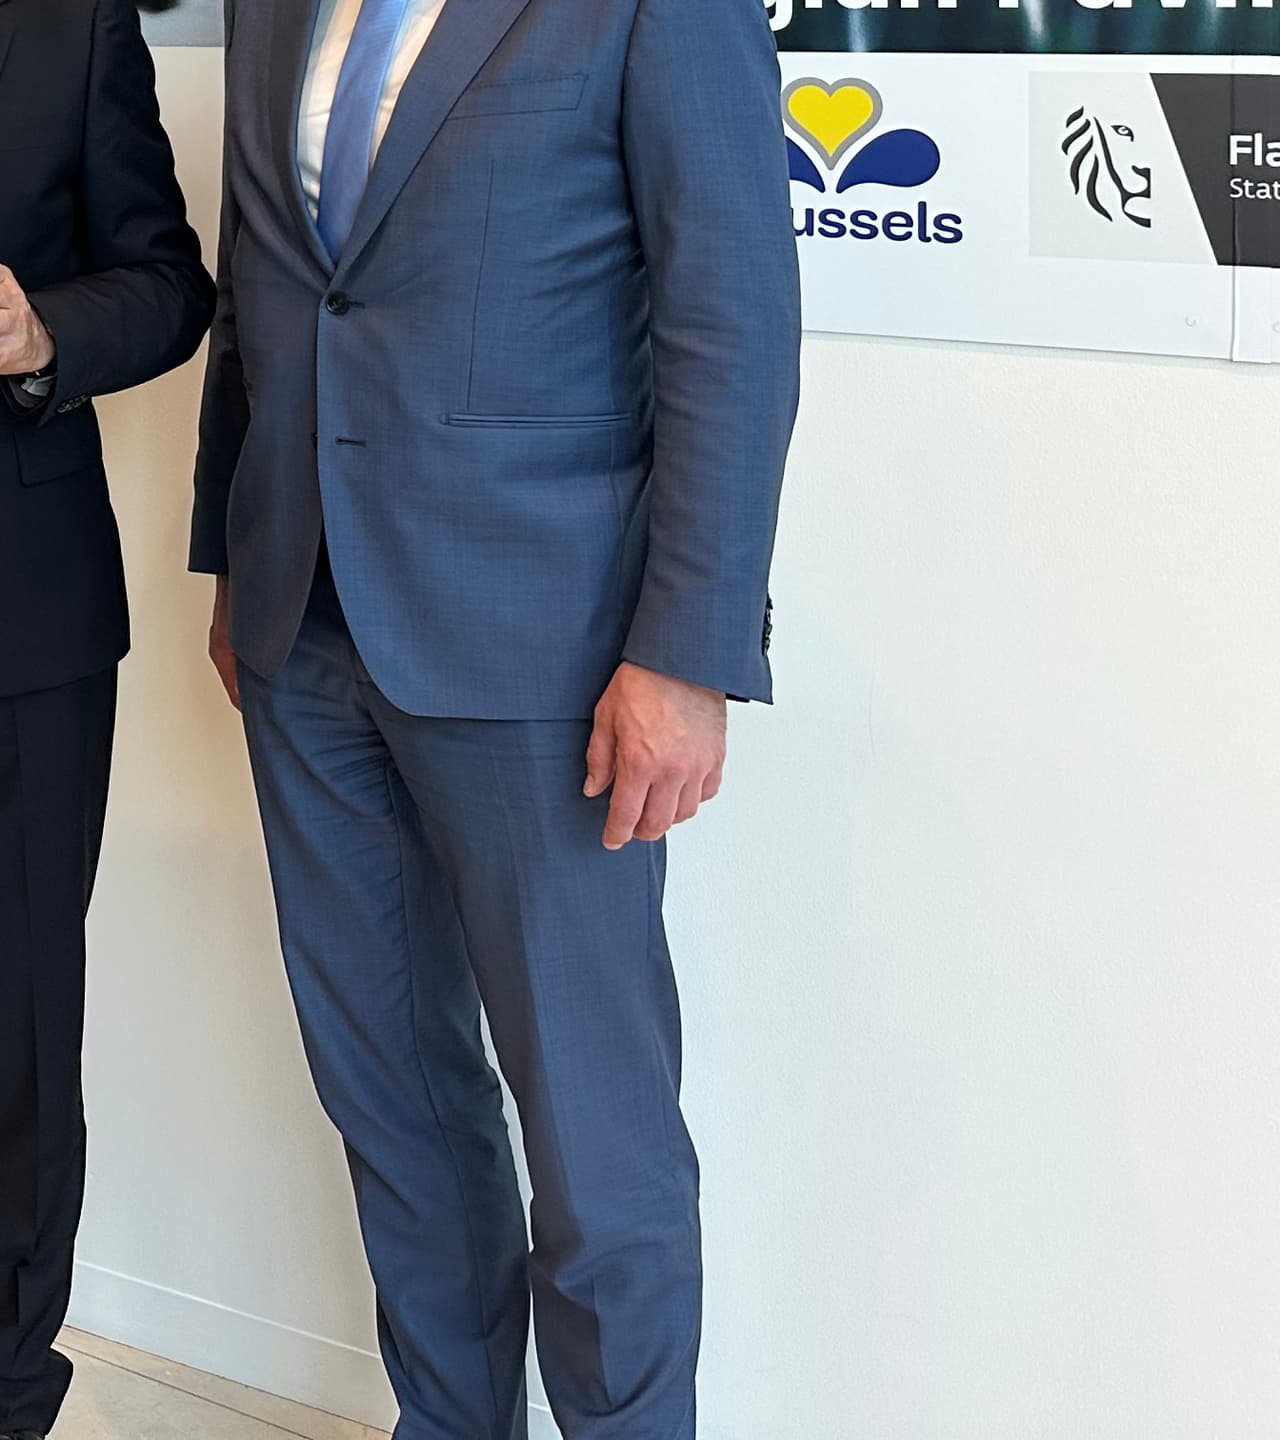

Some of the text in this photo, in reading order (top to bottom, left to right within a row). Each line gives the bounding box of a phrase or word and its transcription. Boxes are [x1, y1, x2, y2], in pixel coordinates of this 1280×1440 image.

[1229, 132, 1280, 168] Fla
[1229, 177, 1280, 201] Stat
[790, 200, 963, 244] ussels
